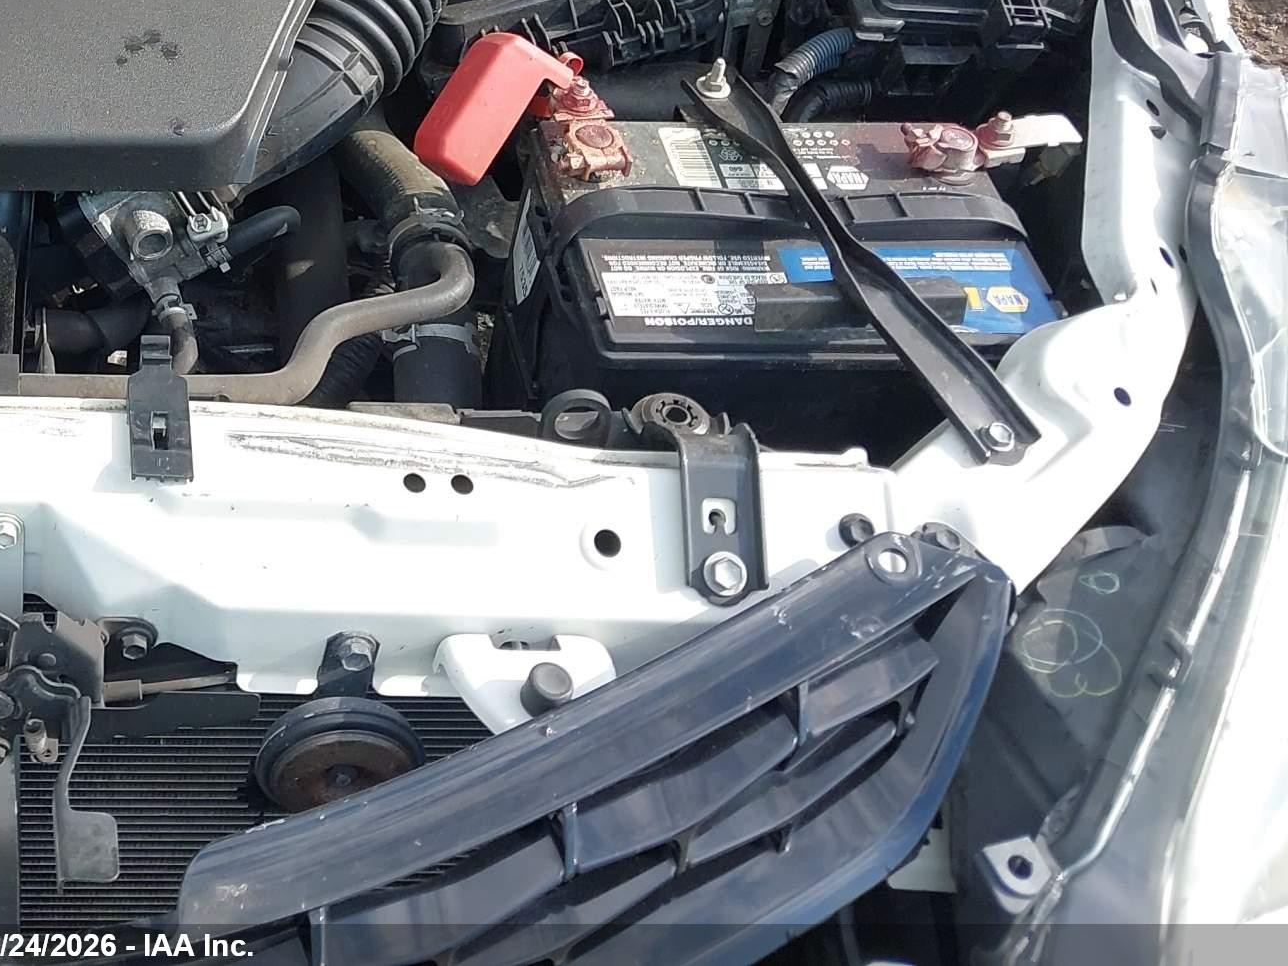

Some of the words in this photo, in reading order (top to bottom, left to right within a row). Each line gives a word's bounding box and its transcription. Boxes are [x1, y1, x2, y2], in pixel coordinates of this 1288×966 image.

[832, 172, 861, 184] NAPA
[992, 294, 1023, 305] NAPA
[644, 316, 753, 326] DANGER/POISON
